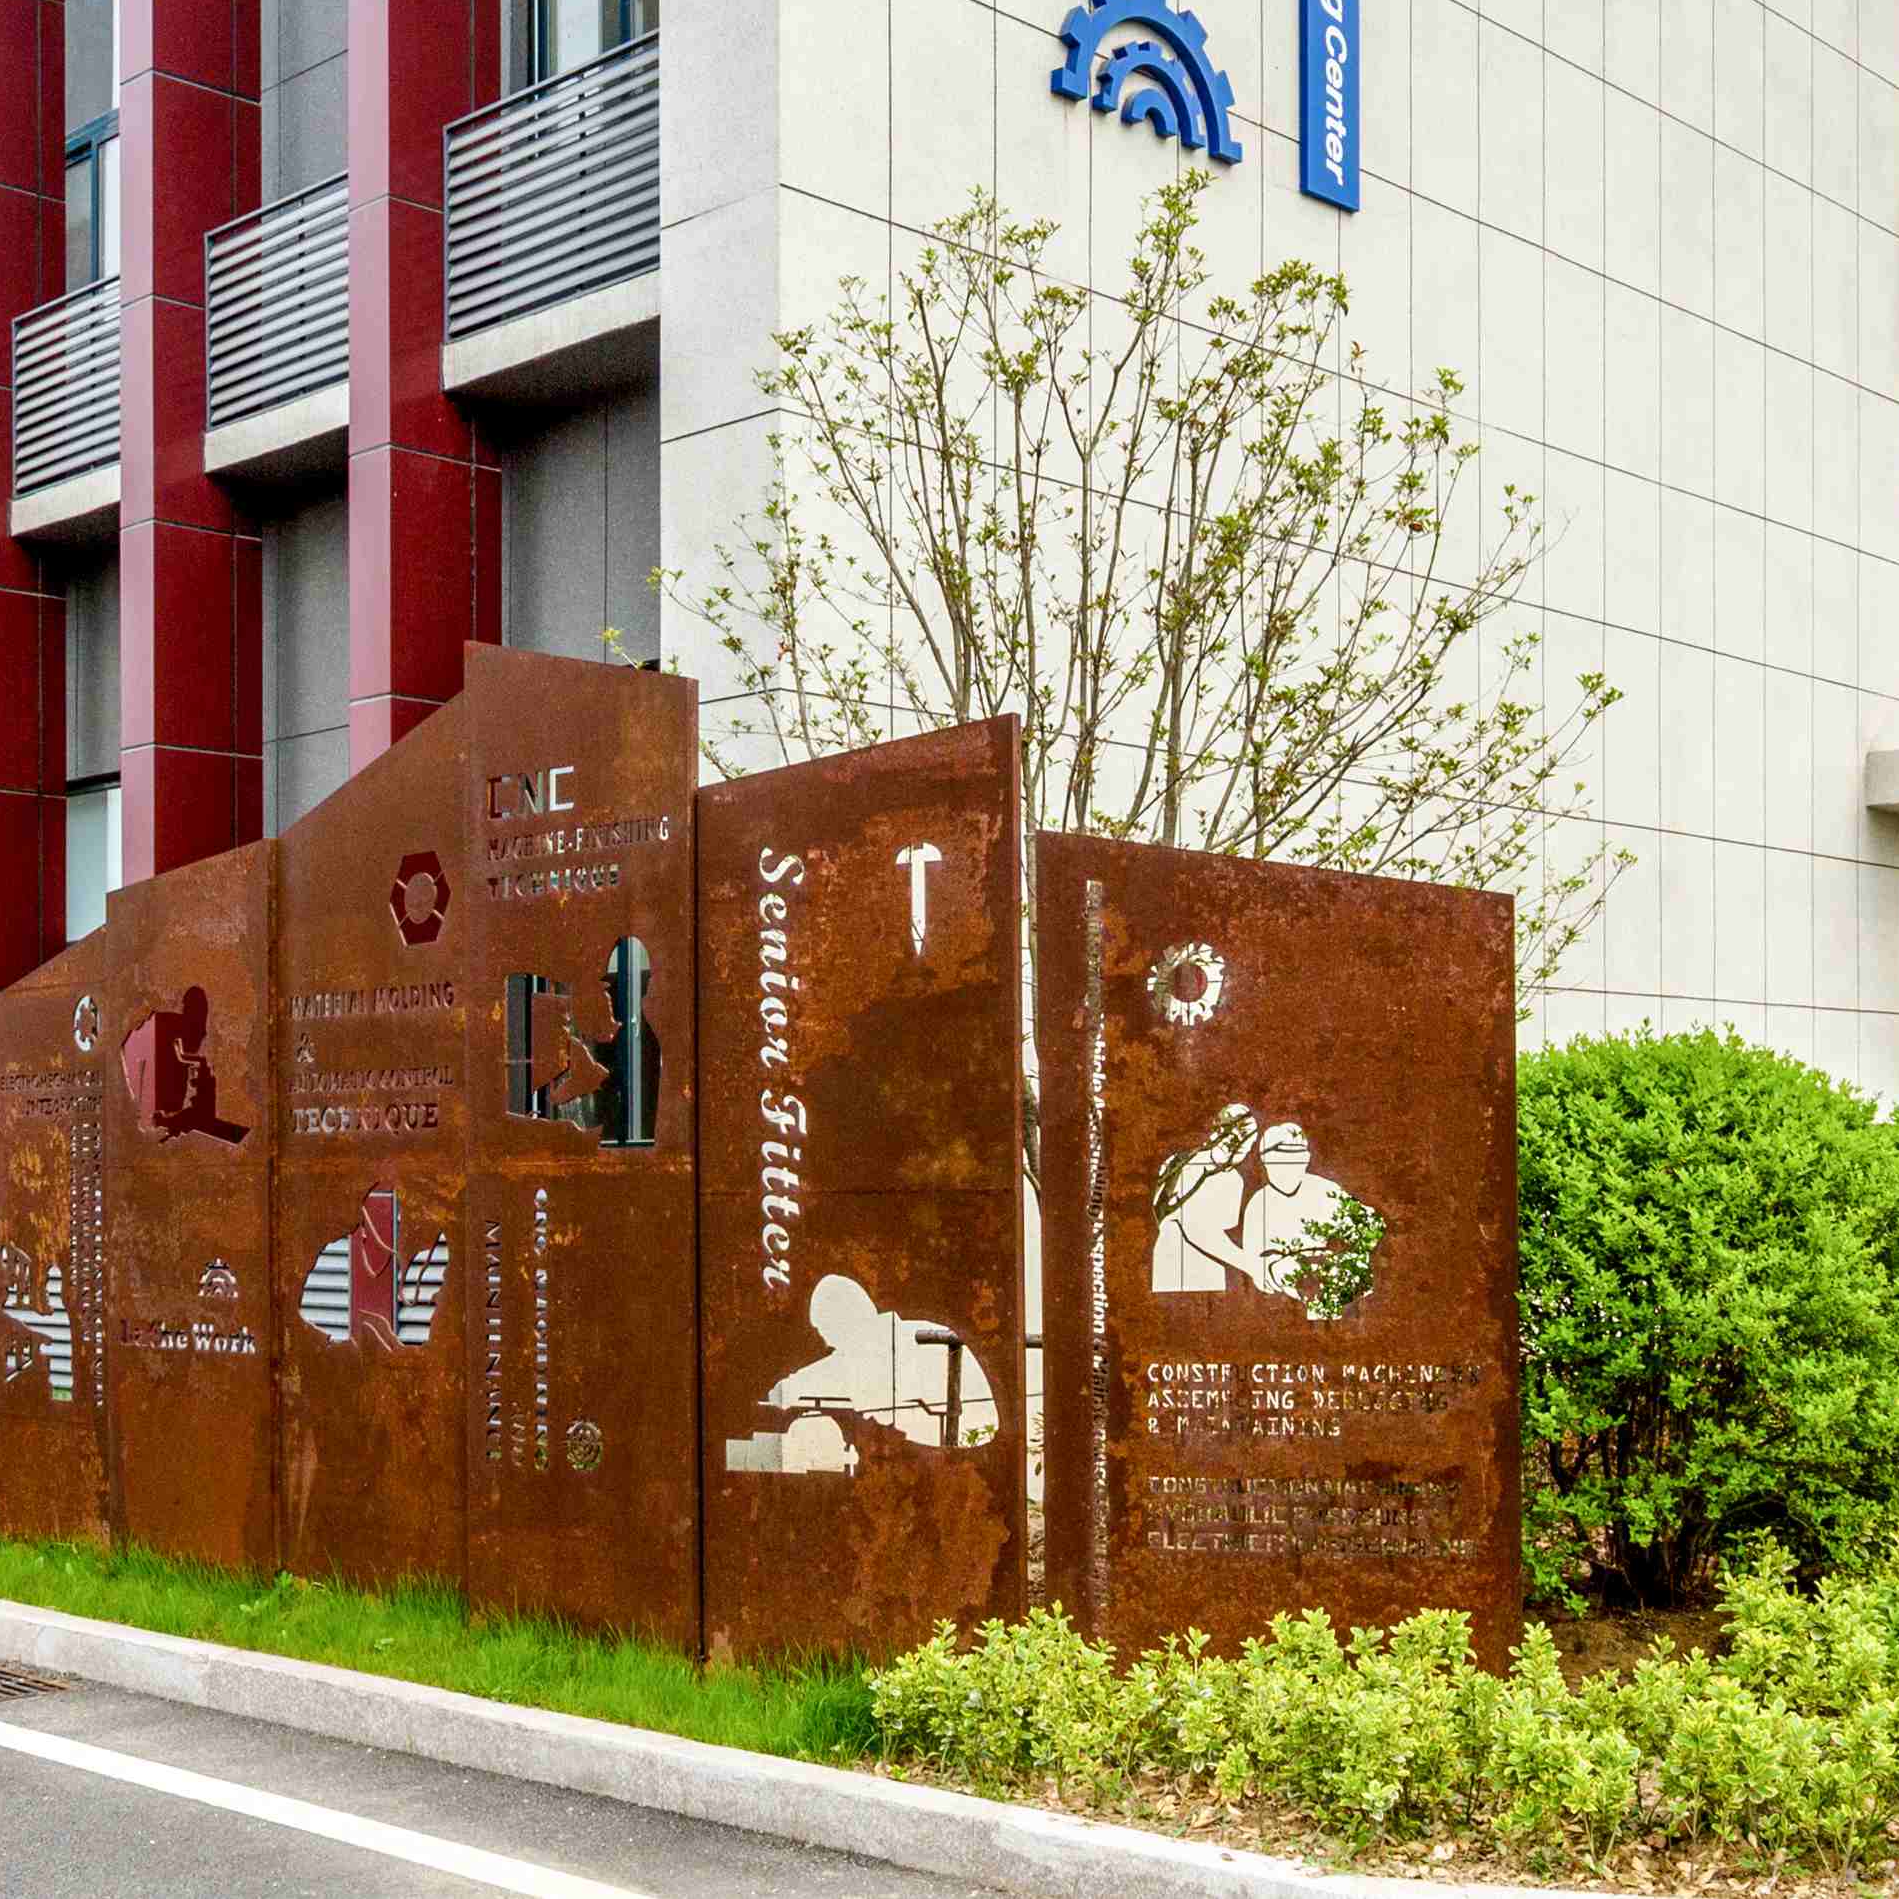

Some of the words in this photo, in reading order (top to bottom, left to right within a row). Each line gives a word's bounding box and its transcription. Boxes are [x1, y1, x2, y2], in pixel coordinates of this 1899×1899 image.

[1319, 26, 1347, 185] Center
[487, 766, 575, 819] CNC
[758, 847, 806, 1068] Senior
[374, 982, 454, 1016] MOLDING
[292, 1103, 439, 1134] TECHNIQUE
[758, 1088, 808, 1289] Fitter
[1147, 1363, 1325, 1384] CONSTRUCTION
[1147, 1417, 1160, 1434] &
